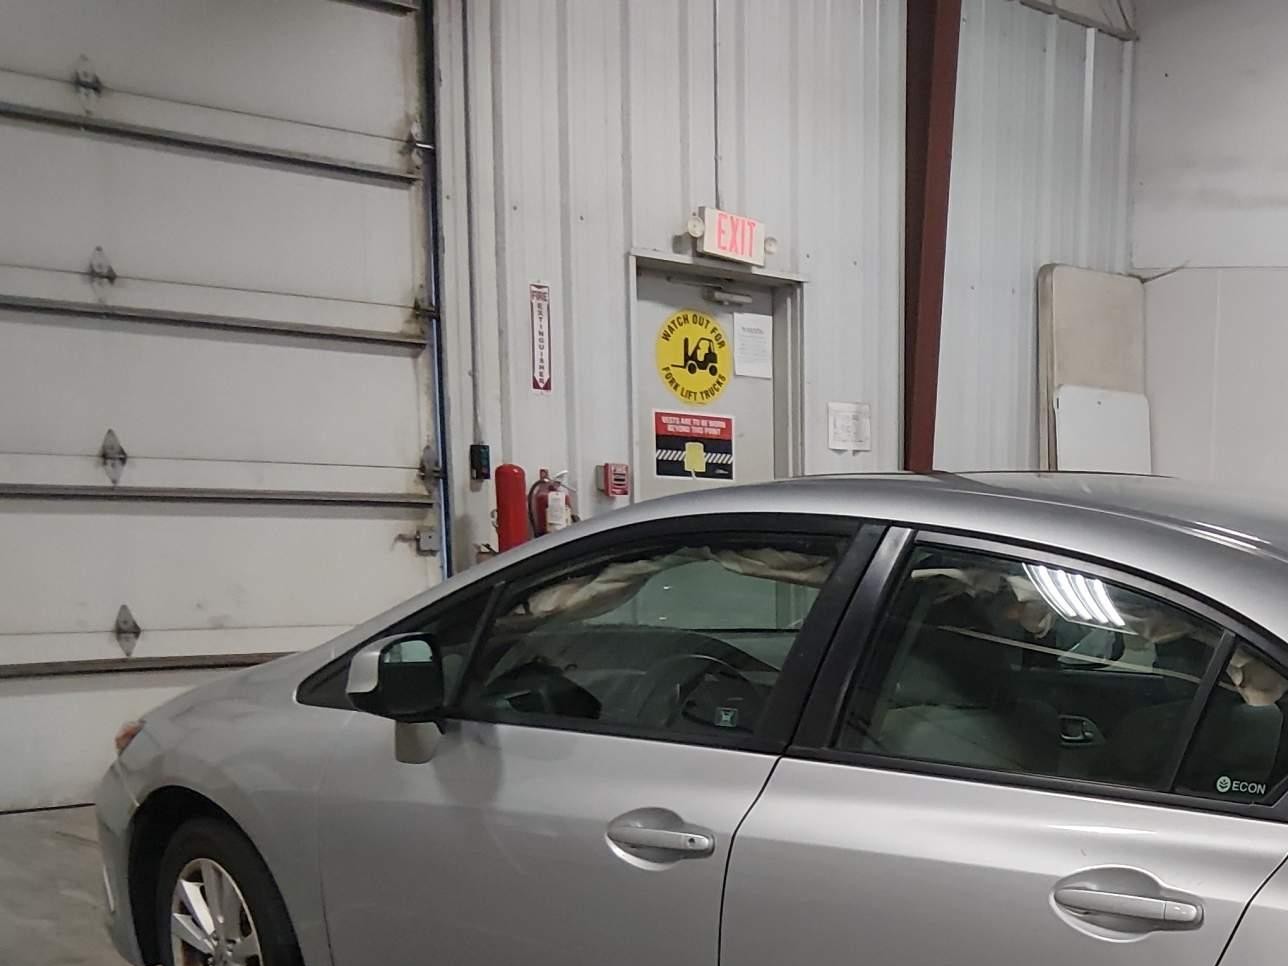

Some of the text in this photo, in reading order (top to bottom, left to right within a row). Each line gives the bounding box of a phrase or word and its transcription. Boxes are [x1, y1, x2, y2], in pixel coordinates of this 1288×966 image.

[717, 213, 756, 258] EXIT
[531, 290, 548, 302] FIRE
[537, 302, 545, 385] EXTINGUISHER
[662, 313, 727, 350] WATCH OUT FOR
[661, 366, 726, 401] FORK LIFT TRUCKS
[1231, 780, 1266, 795] ECON
